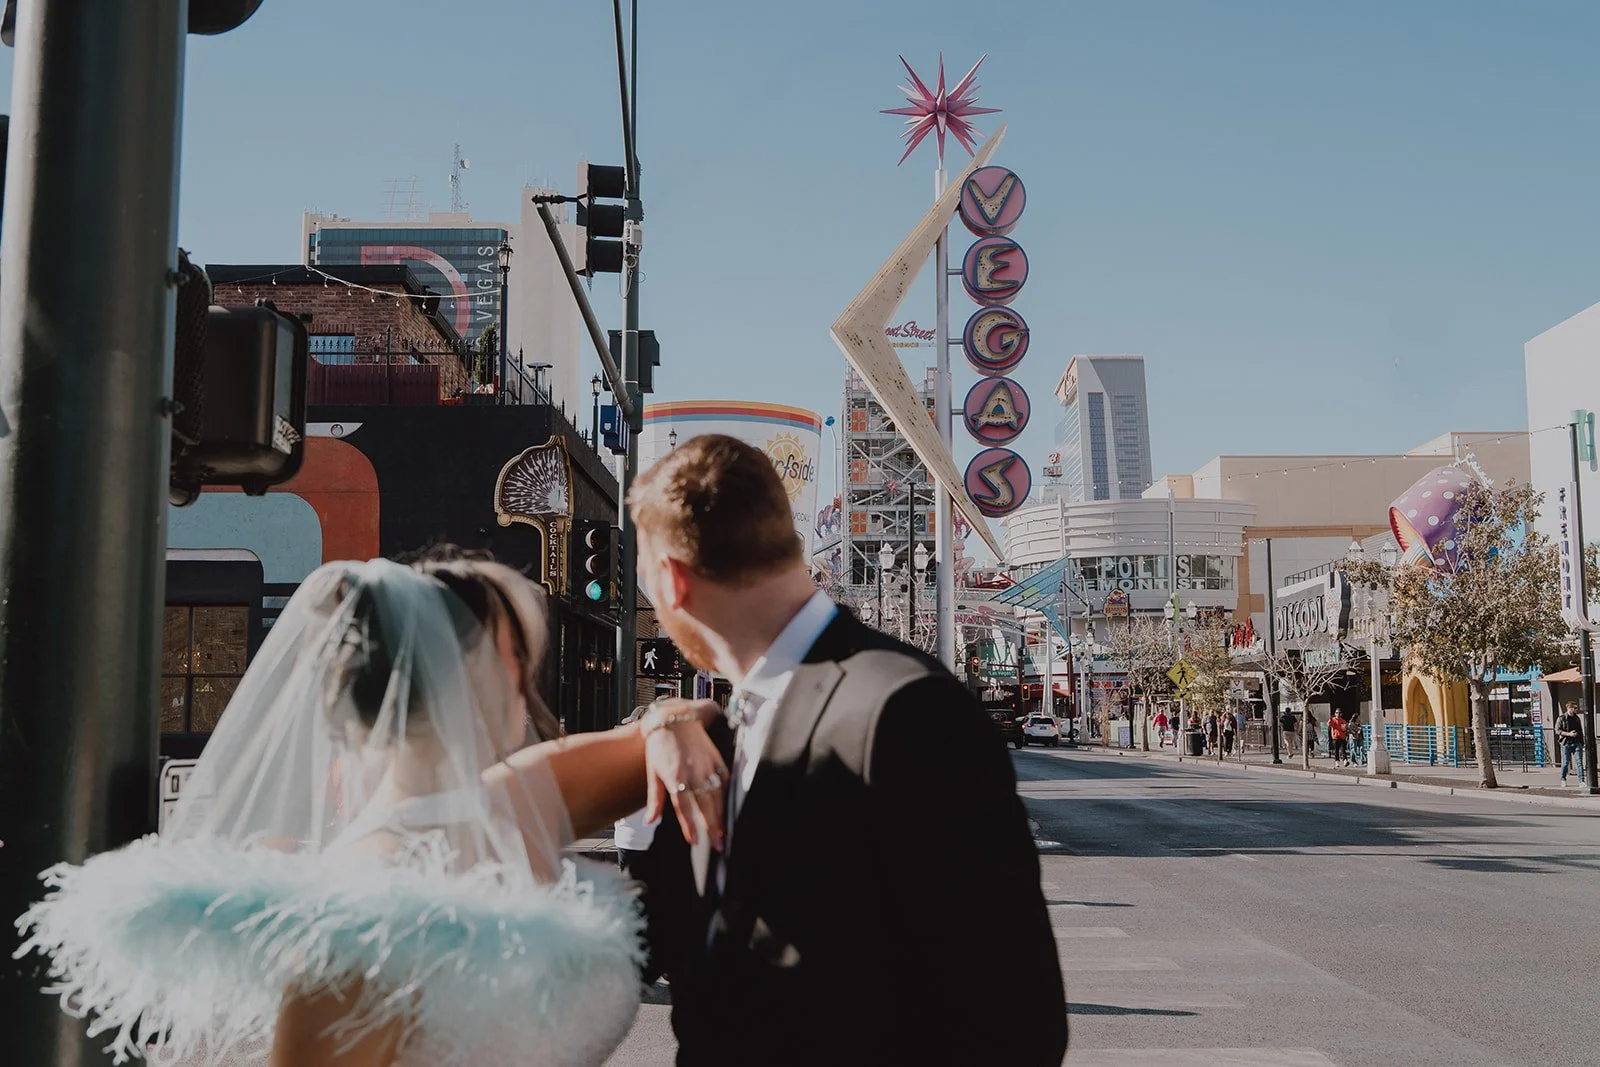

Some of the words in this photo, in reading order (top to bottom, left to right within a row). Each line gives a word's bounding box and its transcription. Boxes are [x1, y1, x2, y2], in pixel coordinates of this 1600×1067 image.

[476, 245, 494, 321] VEGAS
[901, 320, 936, 341] Street
[967, 173, 1029, 508] VEGAS
[549, 521, 558, 577] COCKTAILS
[1177, 578, 1205, 590] ST
